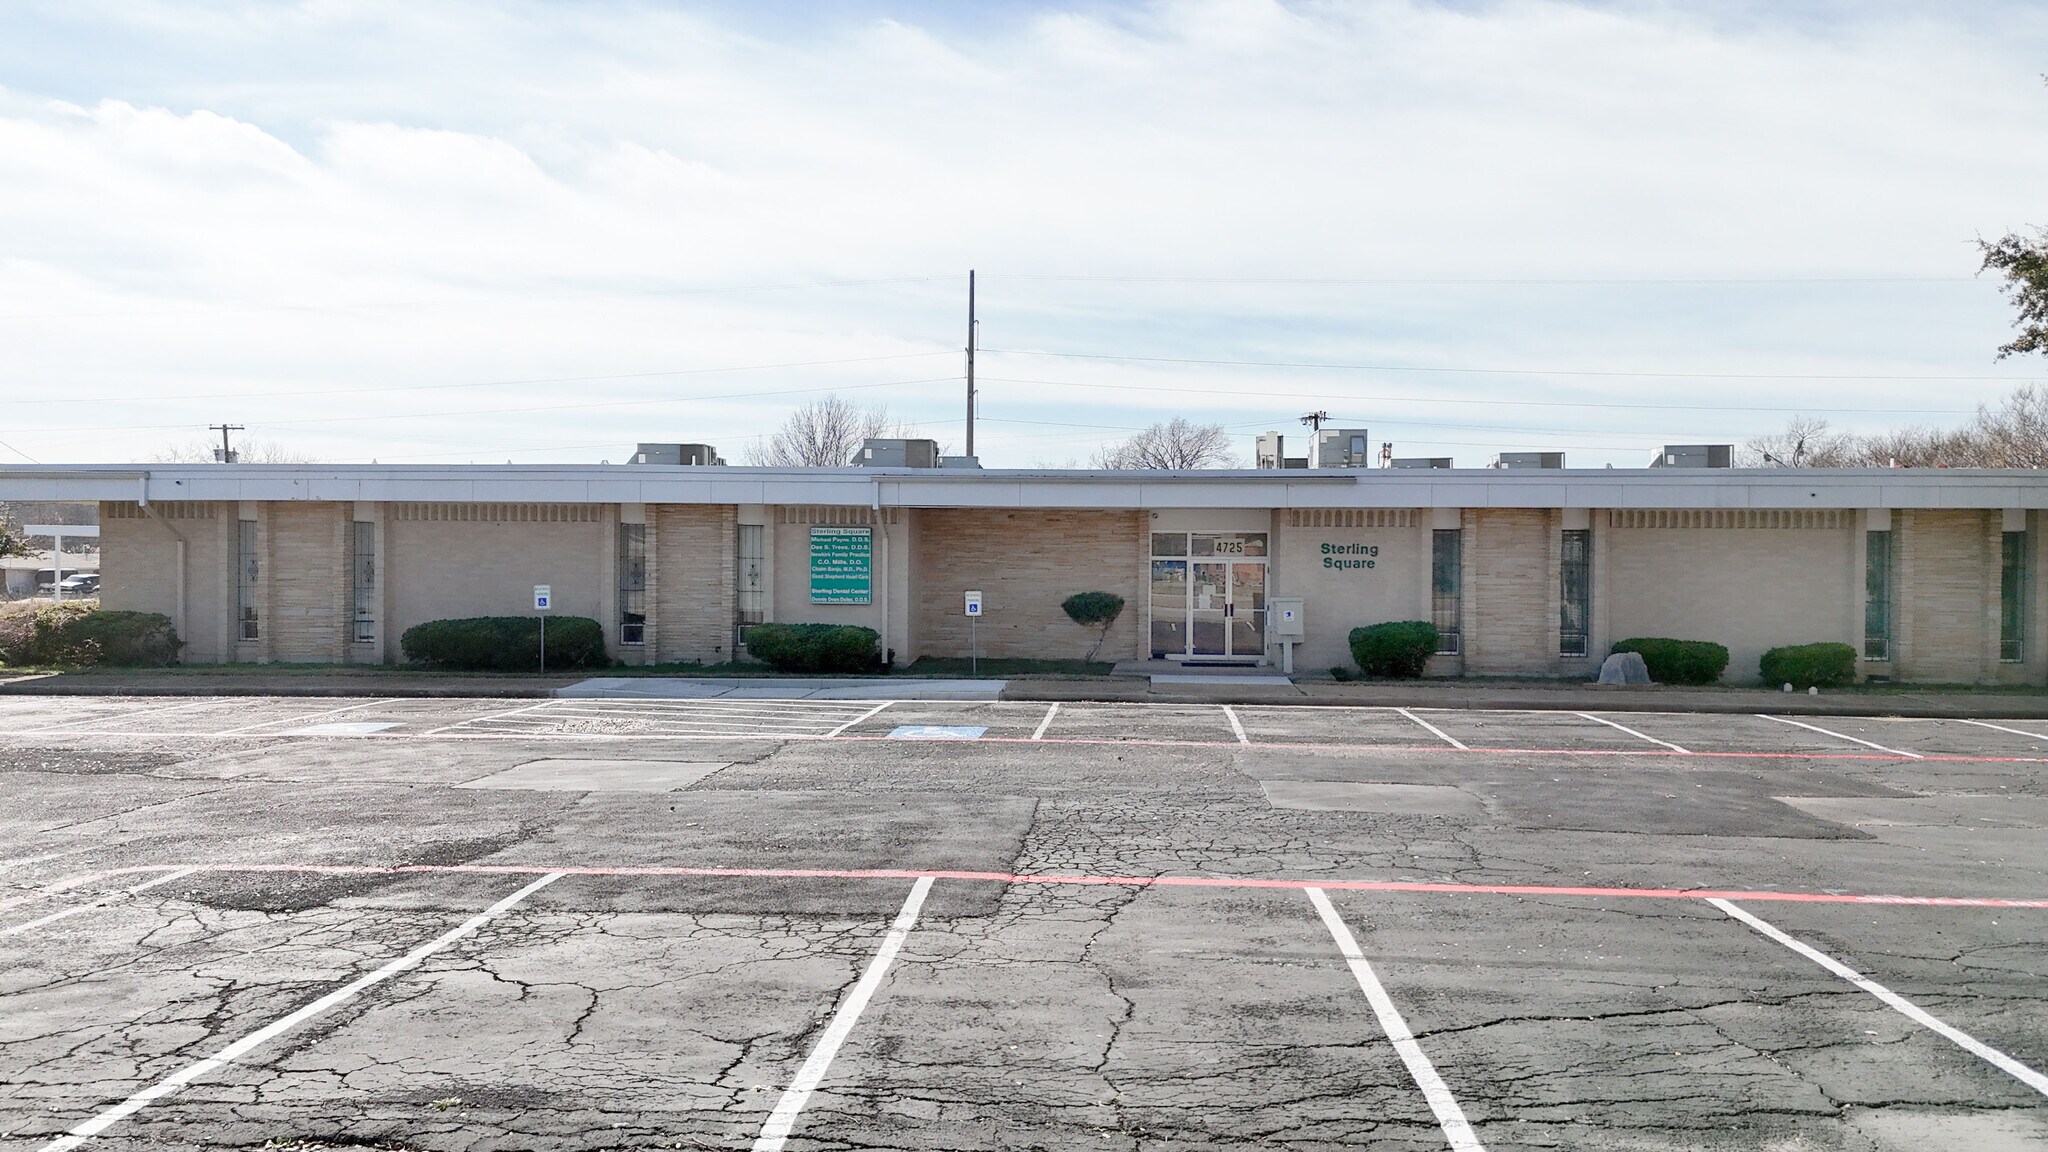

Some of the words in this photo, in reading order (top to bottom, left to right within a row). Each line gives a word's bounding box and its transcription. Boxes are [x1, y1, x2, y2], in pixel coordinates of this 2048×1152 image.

[1216, 542, 1243, 553] 4725
[1320, 543, 1378, 556] Sterling
[1323, 558, 1376, 571] Square
